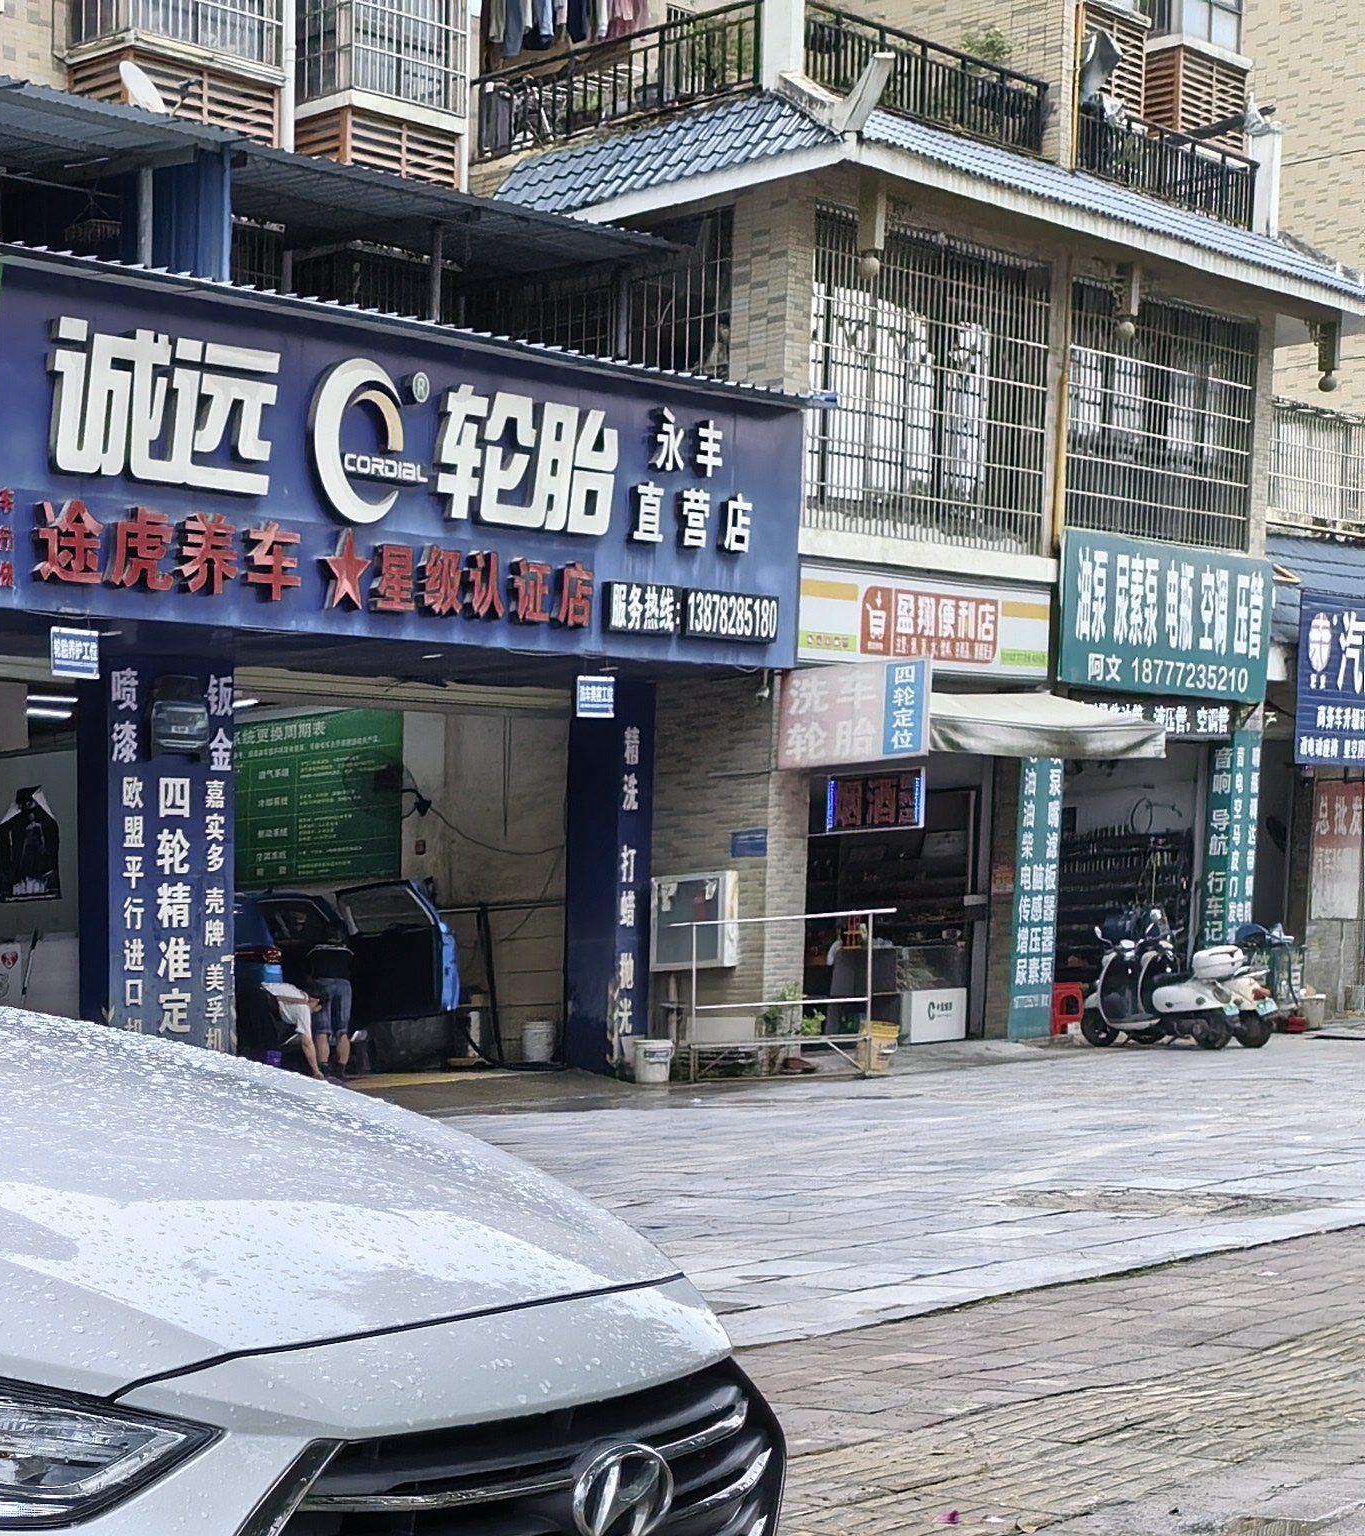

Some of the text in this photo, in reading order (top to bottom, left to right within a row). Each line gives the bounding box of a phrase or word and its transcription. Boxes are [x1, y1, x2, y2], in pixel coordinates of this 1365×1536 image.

[47, 316, 619, 536] 诚远 轮胎
[650, 407, 723, 478] 永丰
[344, 453, 428, 483] CORDIAL
[631, 482, 753, 554] 直营店
[32, 500, 594, 628] 途虎养车 星级认证店
[1076, 546, 1108, 643] 油泵
[1114, 553, 1159, 648] 尿素泵
[1199, 565, 1229, 656] 空调
[688, 591, 777, 638] 13878285180
[788, 672, 877, 716] 洗车
[890, 665, 916, 749] 四轮定位
[1088, 653, 1249, 693] 阿文 18777235210
[111, 667, 139, 764] 喷漆
[205, 674, 233, 771] 钣金
[786, 716, 877, 762] 轮胎
[205, 780, 226, 872] 嘉实多
[156, 777, 192, 1034] 四轮精准定
[205, 887, 226, 947] 壳牌
